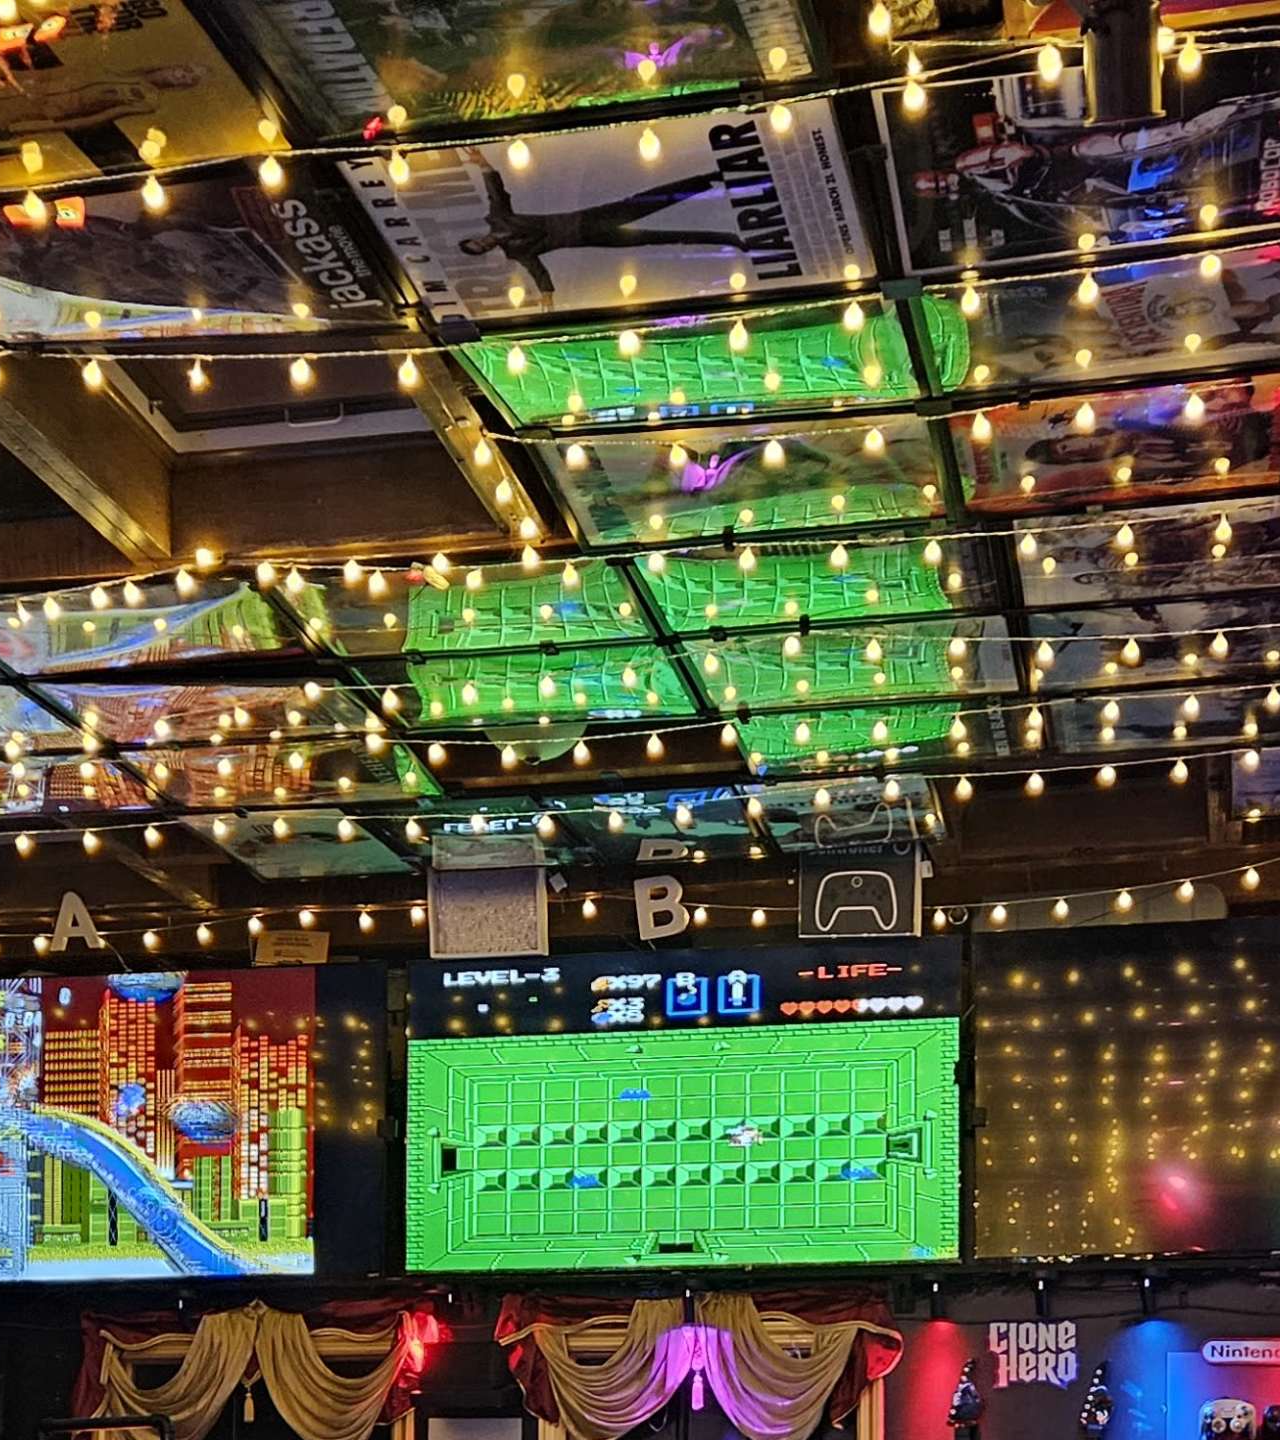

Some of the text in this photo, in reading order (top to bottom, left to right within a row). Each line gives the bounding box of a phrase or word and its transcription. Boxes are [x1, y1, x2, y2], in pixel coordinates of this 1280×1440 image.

[290, 0, 393, 112] REDATOR
[708, 122, 778, 200] LIAR
[347, 158, 431, 264] CARREY
[736, 200, 807, 281] LIAR
[271, 199, 384, 309] jackass
[50, 890, 100, 952] A
[634, 874, 690, 941] B
[59, 987, 72, 1005] 0
[443, 966, 561, 988] LEVEL-3
